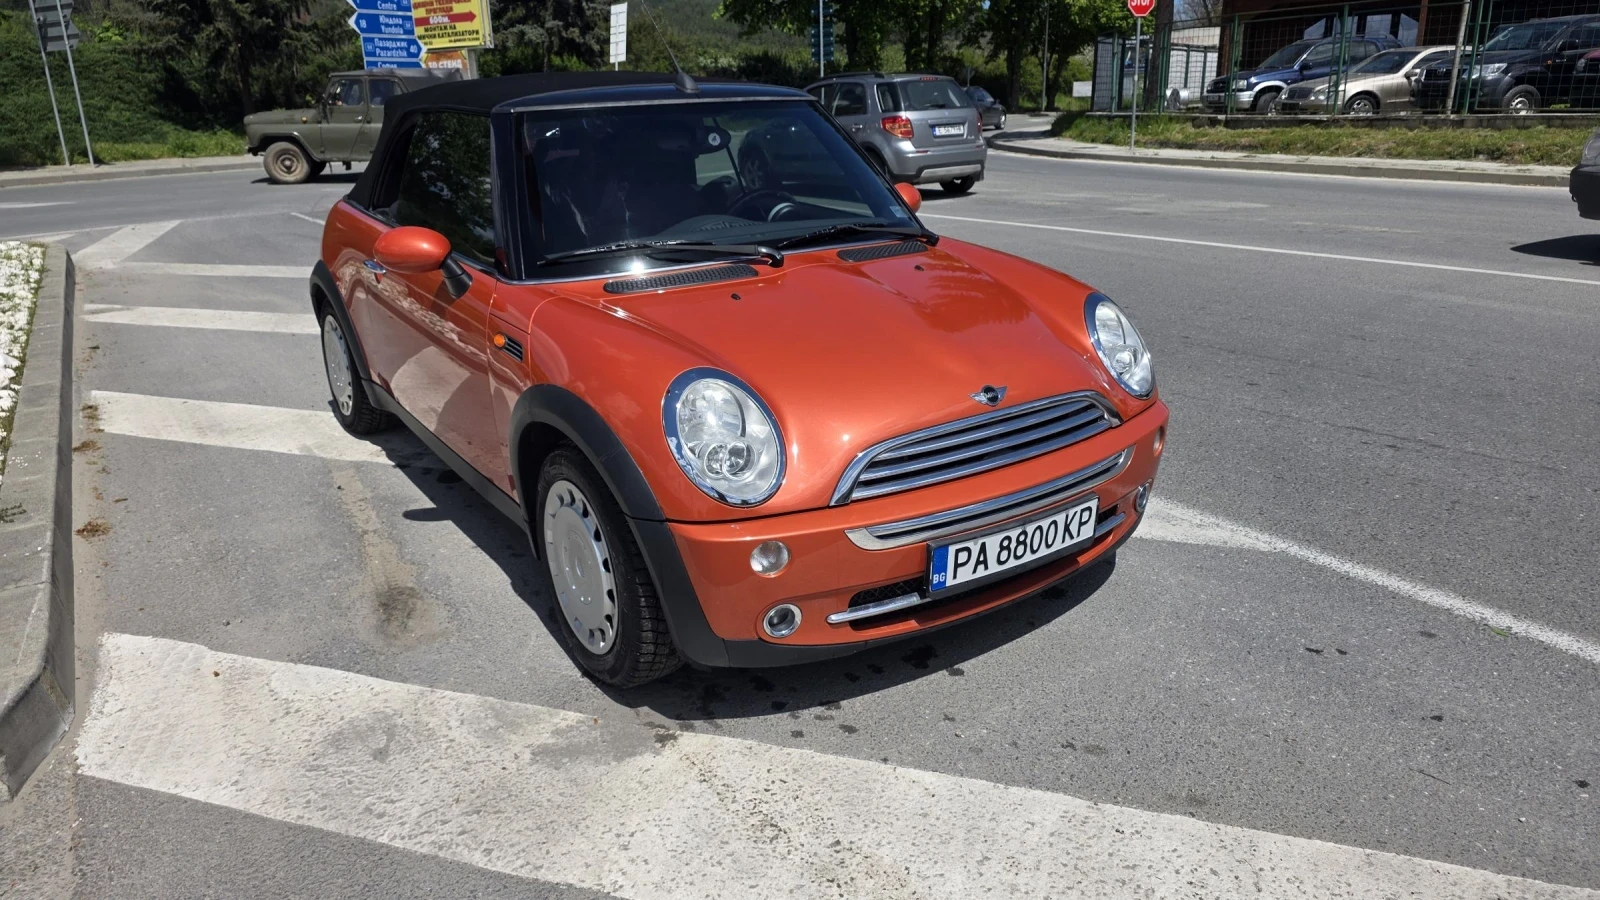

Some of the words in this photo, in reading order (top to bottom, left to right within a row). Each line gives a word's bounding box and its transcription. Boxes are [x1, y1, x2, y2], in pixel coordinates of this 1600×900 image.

[377, 0, 397, 10] Centre
[359, 19, 367, 28] 18
[379, 15, 402, 24] Юндола
[380, 24, 404, 34] Yundola
[437, 29, 480, 39] КАТАЛИЗАТОРИ
[374, 38, 408, 48] Пазарджик
[375, 48, 408, 57] Pazardzhik
[409, 45, 418, 54] 40
[438, 58, 462, 68] СТЕНД
[952, 541, 989, 580] PA
[996, 519, 1059, 566] 8800
[1061, 505, 1093, 544] KP
[933, 573, 946, 584] BG
